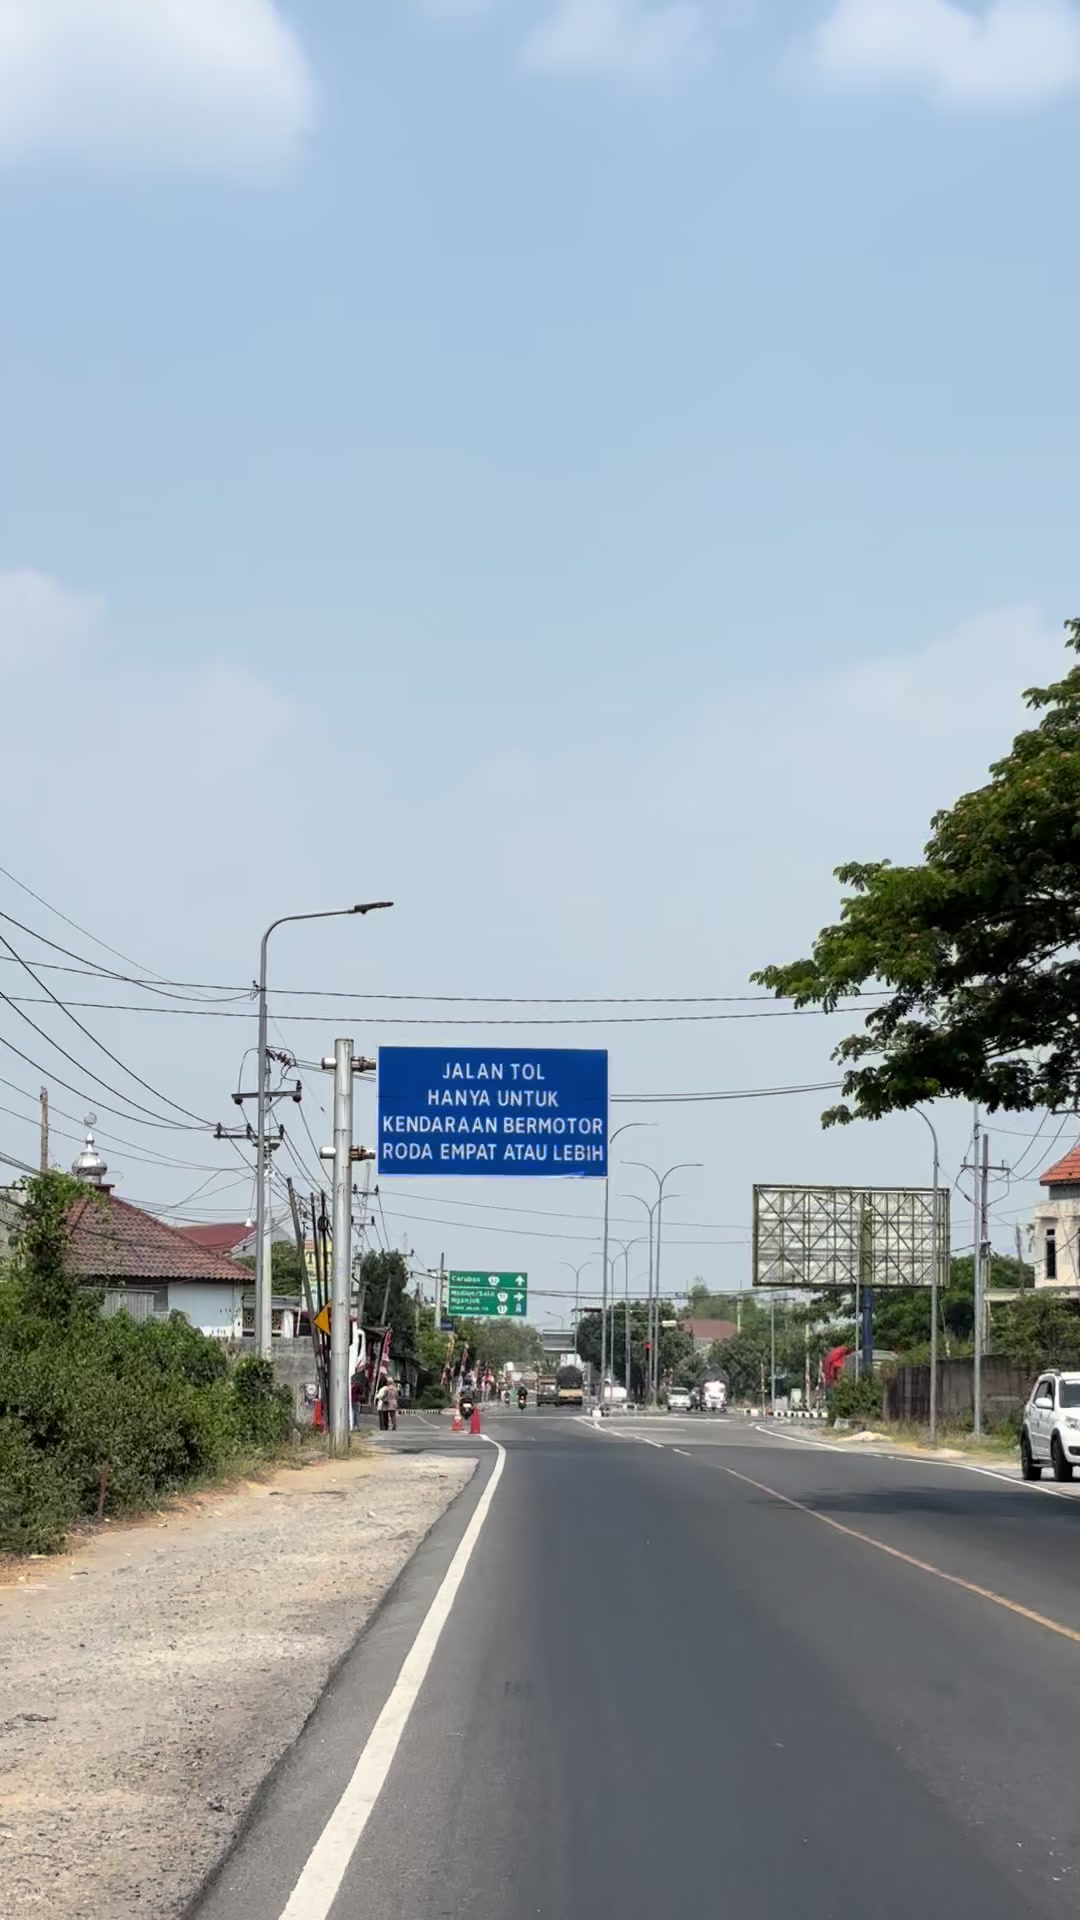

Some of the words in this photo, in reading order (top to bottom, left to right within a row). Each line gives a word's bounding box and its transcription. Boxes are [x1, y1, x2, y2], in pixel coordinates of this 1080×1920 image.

[443, 1063, 502, 1079] JALAN
[511, 1064, 544, 1079] TOL
[429, 1090, 489, 1105] HANYA
[498, 1091, 557, 1106] UNTUK
[384, 1117, 496, 1132] KENDARAAN
[504, 1118, 602, 1133] BERMOTOR
[384, 1143, 432, 1159] RODA
[441, 1144, 496, 1159] EMPAT
[504, 1144, 546, 1160] ATAU
[554, 1145, 602, 1160] LEBIH
